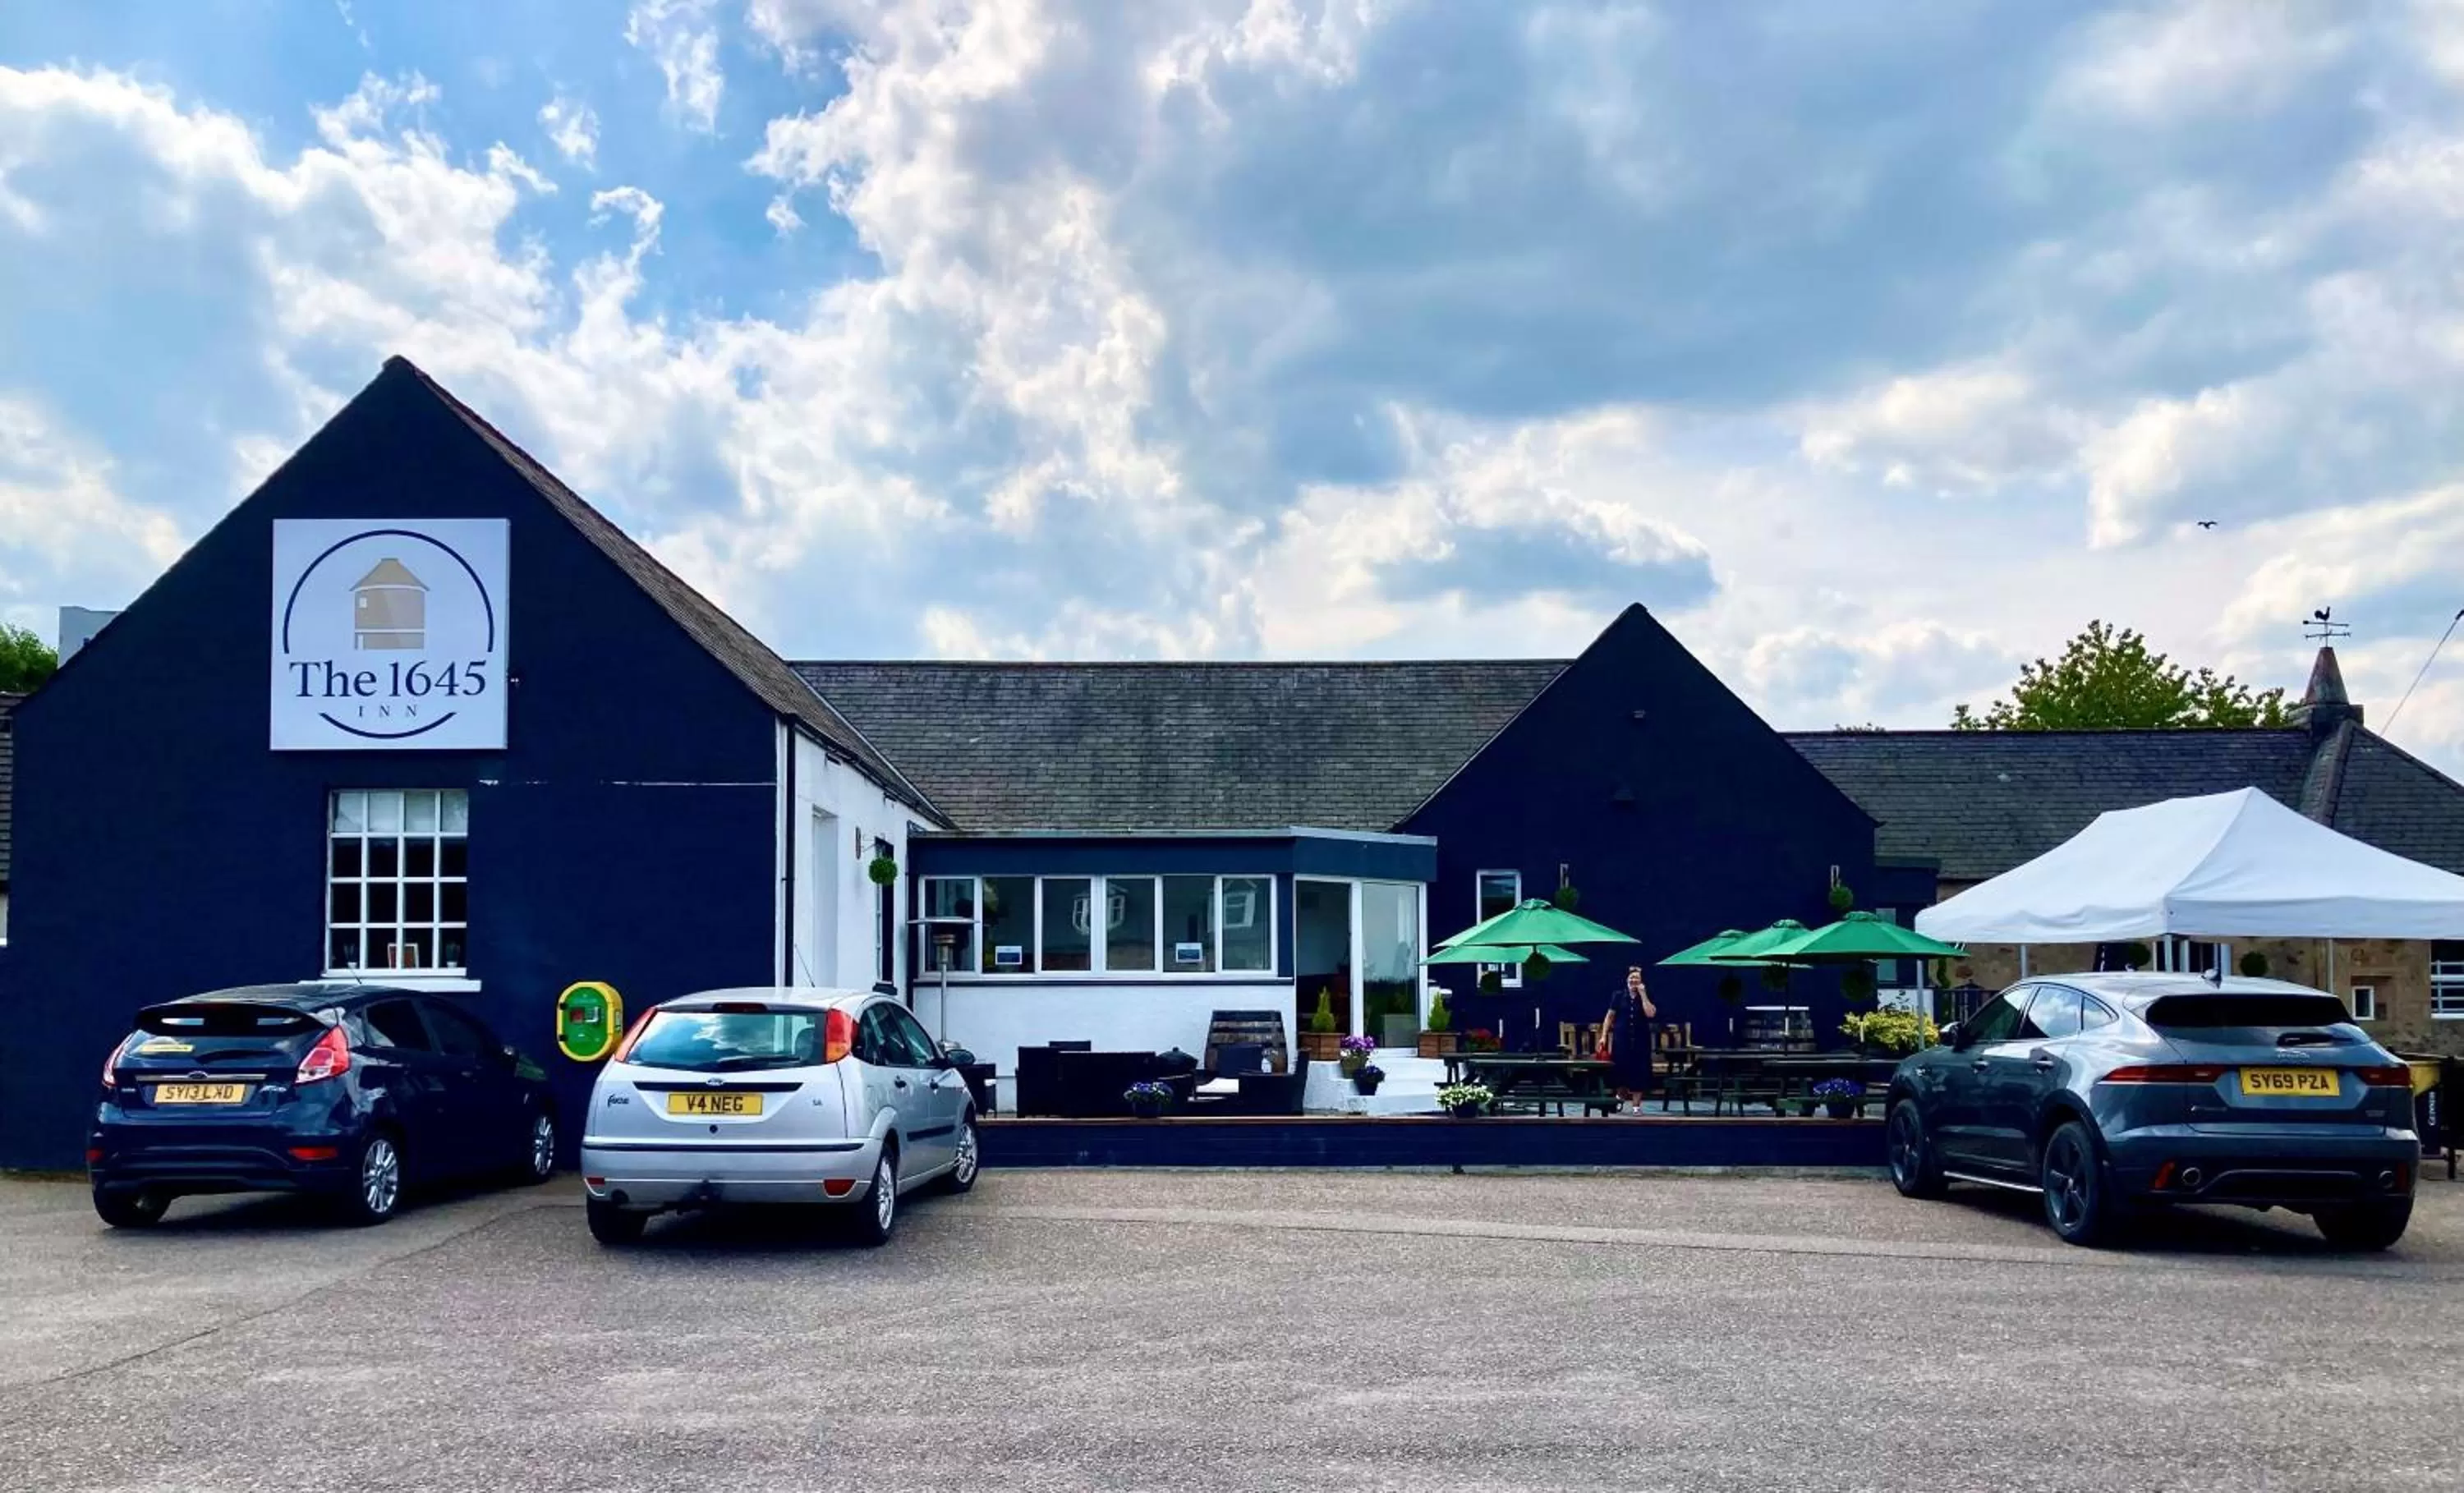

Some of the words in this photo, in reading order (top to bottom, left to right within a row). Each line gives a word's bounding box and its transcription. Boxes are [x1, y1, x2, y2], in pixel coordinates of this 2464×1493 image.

[289, 659, 377, 697] The
[388, 659, 487, 697] 1645
[358, 704, 417, 718] INN
[2250, 1073, 2294, 1090] SY69
[2297, 1074, 2330, 1090] PZA
[165, 1085, 200, 1100] SY13
[687, 1096, 707, 1111] V4
[710, 1096, 743, 1111] NEG
